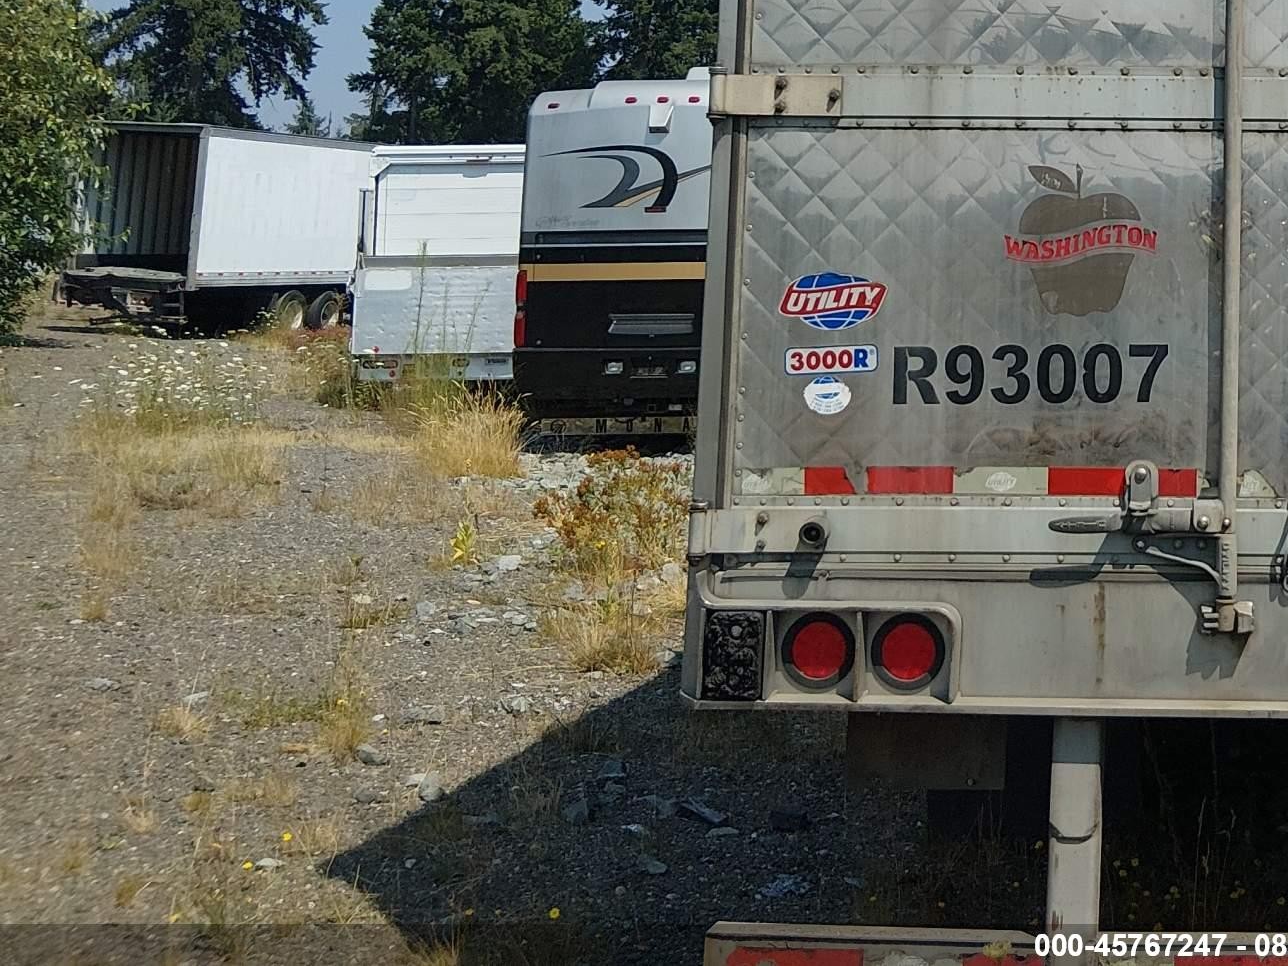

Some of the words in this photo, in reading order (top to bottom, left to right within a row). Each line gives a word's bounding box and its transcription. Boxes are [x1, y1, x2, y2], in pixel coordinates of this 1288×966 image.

[1004, 224, 1158, 260] WASHINGTON
[786, 286, 882, 313] UTILITY
[892, 343, 1169, 405] R93007
